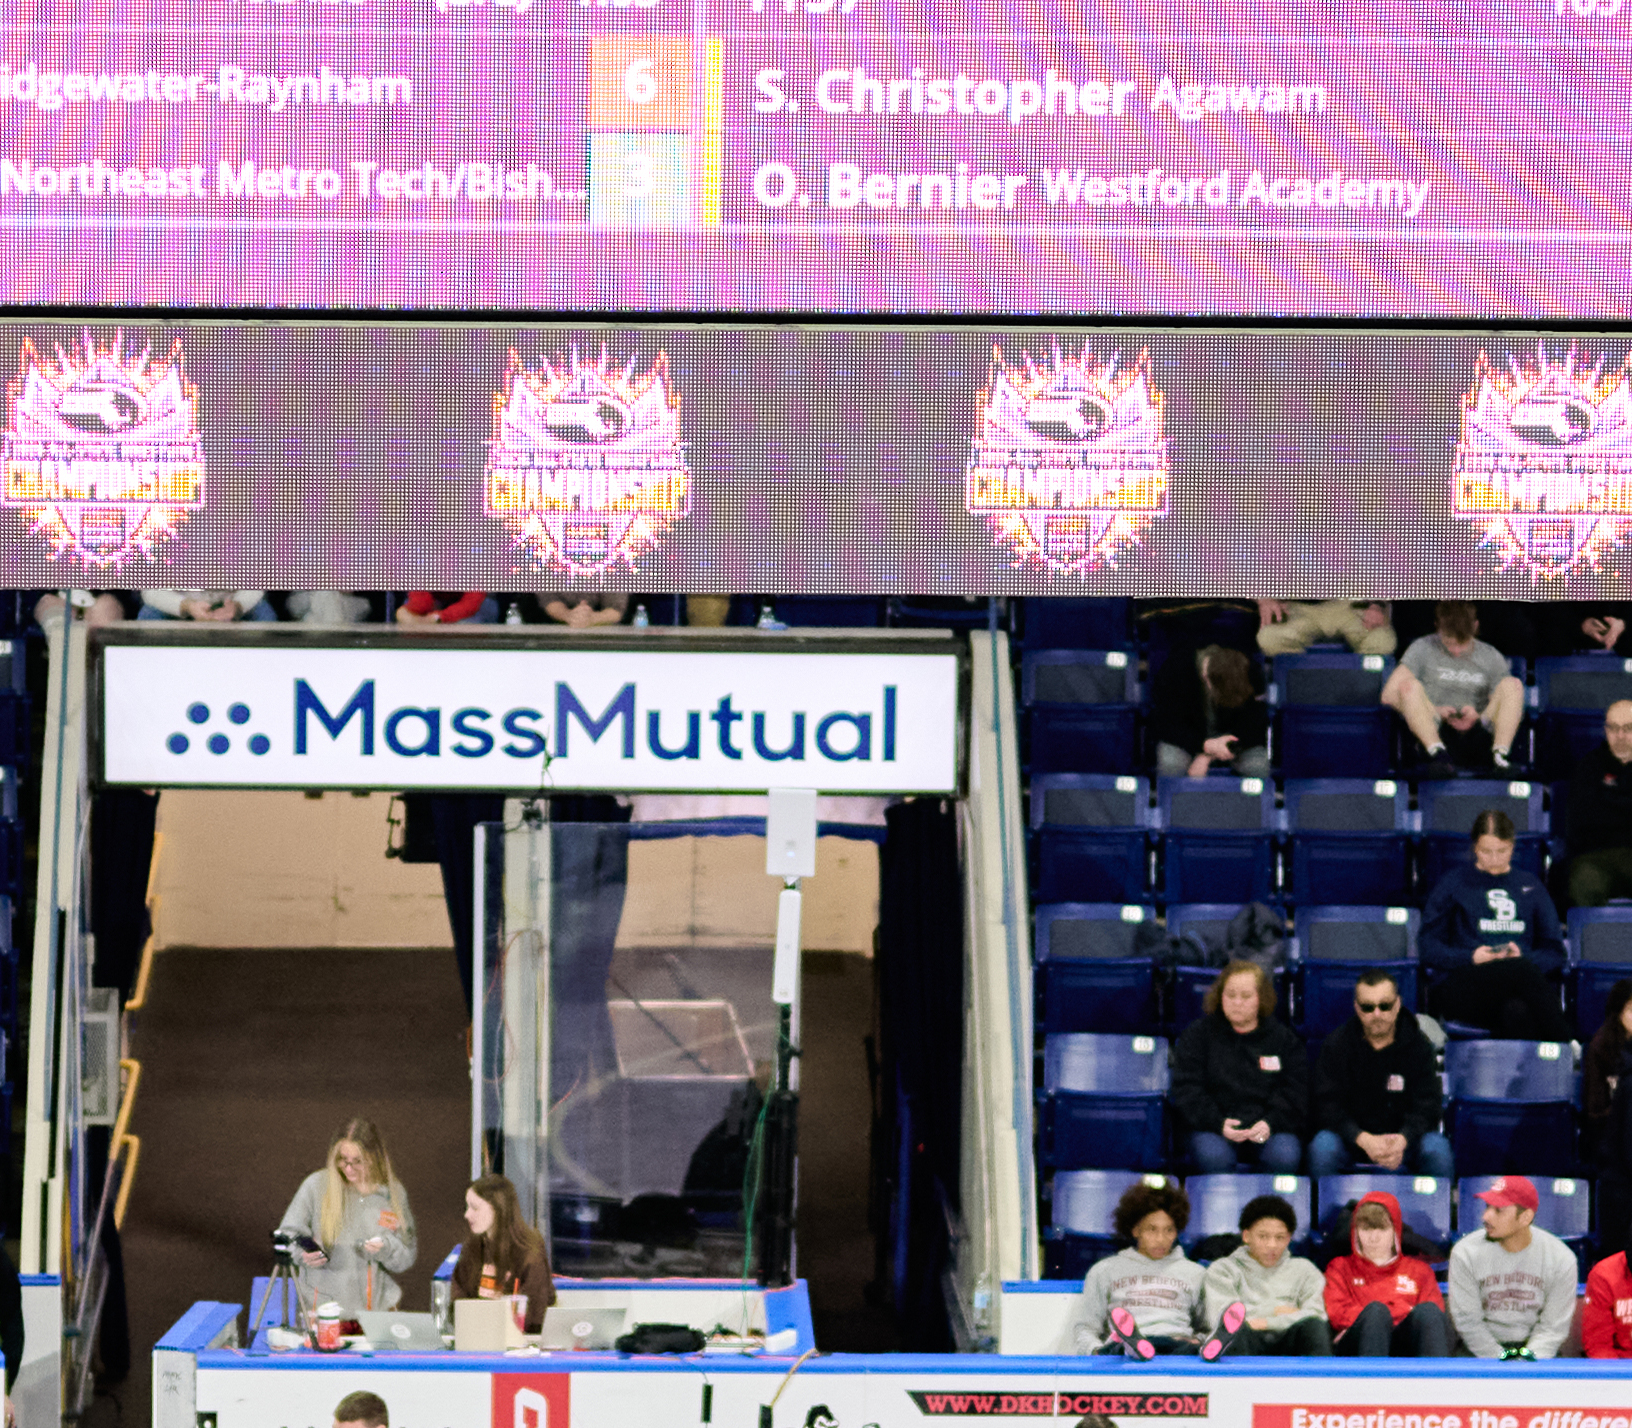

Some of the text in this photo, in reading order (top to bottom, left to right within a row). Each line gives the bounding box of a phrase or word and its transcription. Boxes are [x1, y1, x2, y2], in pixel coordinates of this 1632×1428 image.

[623, 62, 656, 103] 6
[753, 66, 1326, 124] S. Christopher Agawam
[0, 157, 207, 199] Northeast
[218, 158, 341, 201] Metro
[622, 152, 655, 198] 3
[755, 161, 1432, 216] O. Bernier Westford Academy
[293, 676, 898, 763] MassMutual
[1479, 919, 1526, 933] WRESTLING
[925, 1393, 1209, 1416] WWW.DKHOCKEY.COM
